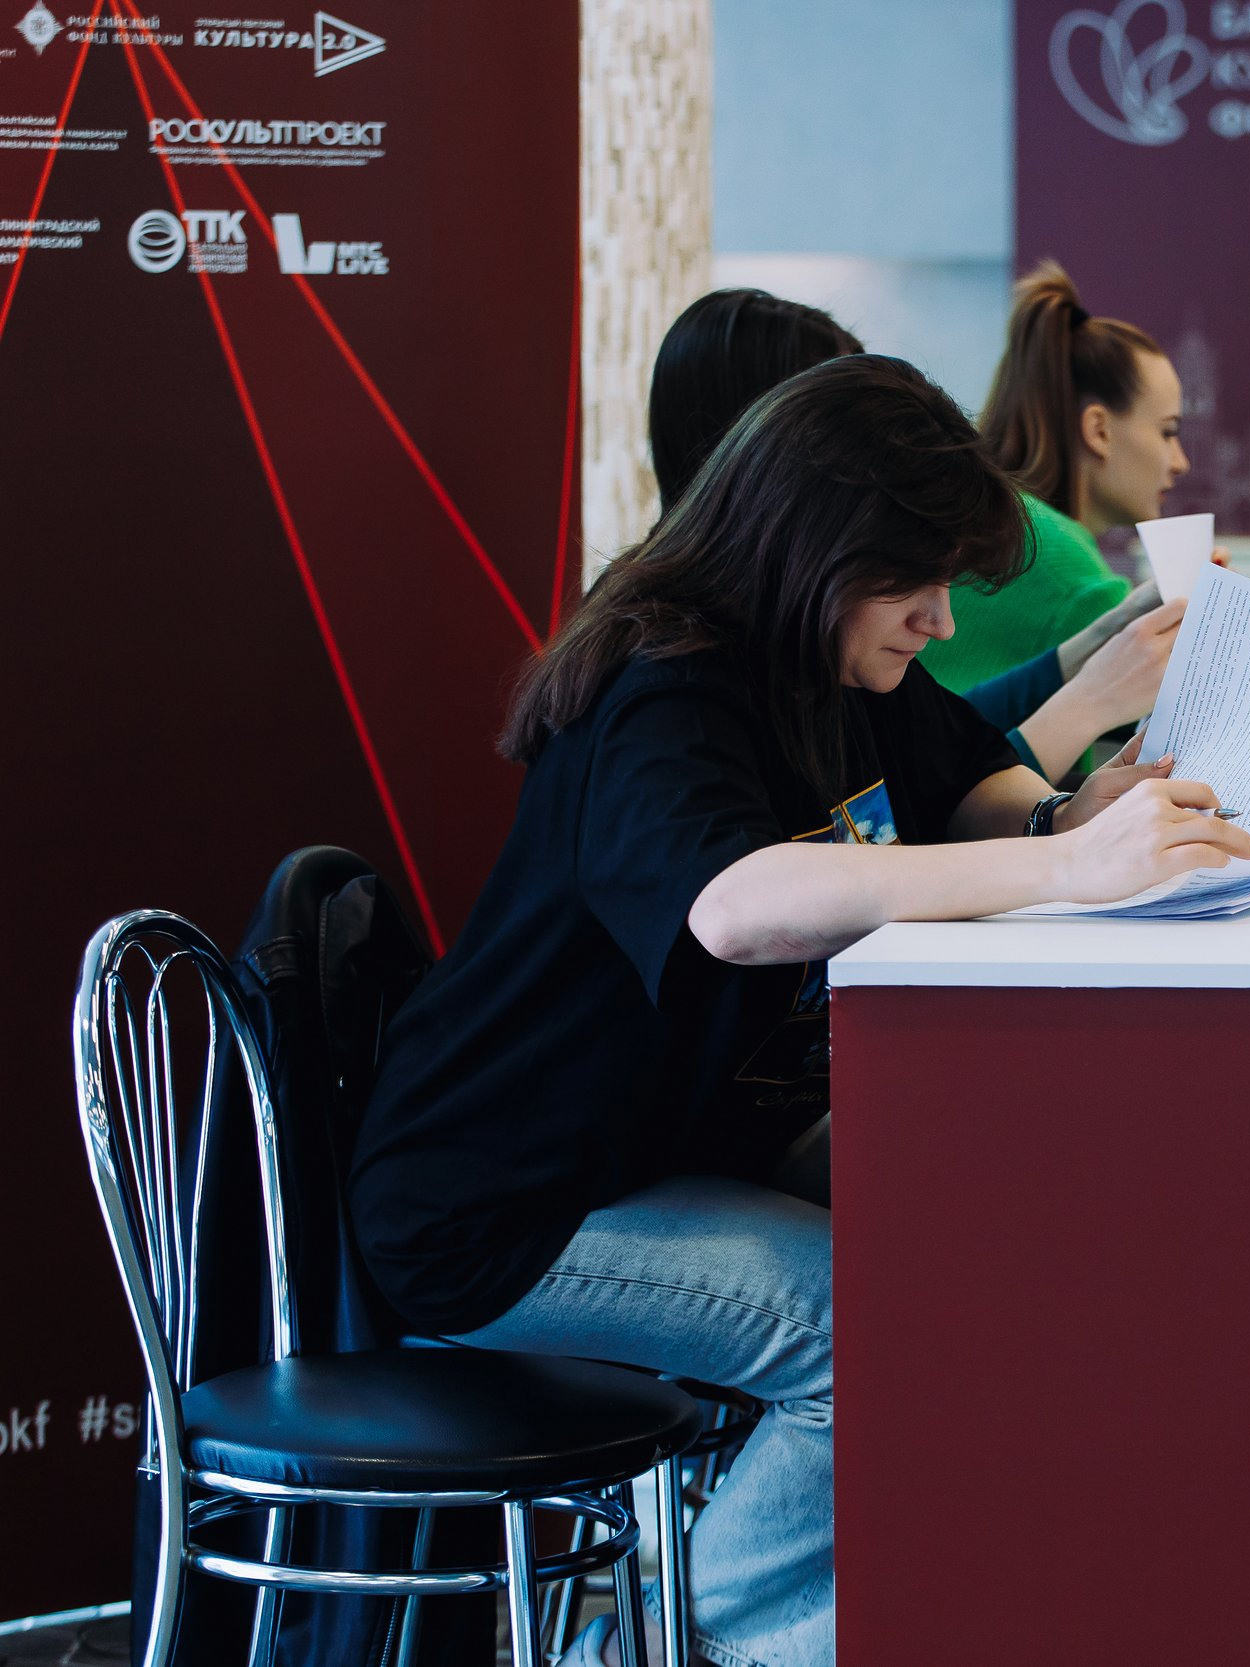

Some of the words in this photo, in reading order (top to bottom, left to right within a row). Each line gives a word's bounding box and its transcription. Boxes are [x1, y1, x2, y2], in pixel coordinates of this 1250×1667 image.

[194, 30, 315, 48] КУЛЬТУРА
[149, 118, 387, 145] РОСКУЛЬТПРОЕКТ
[182, 210, 247, 243] ТТК
[80, 1395, 141, 1442] #s
